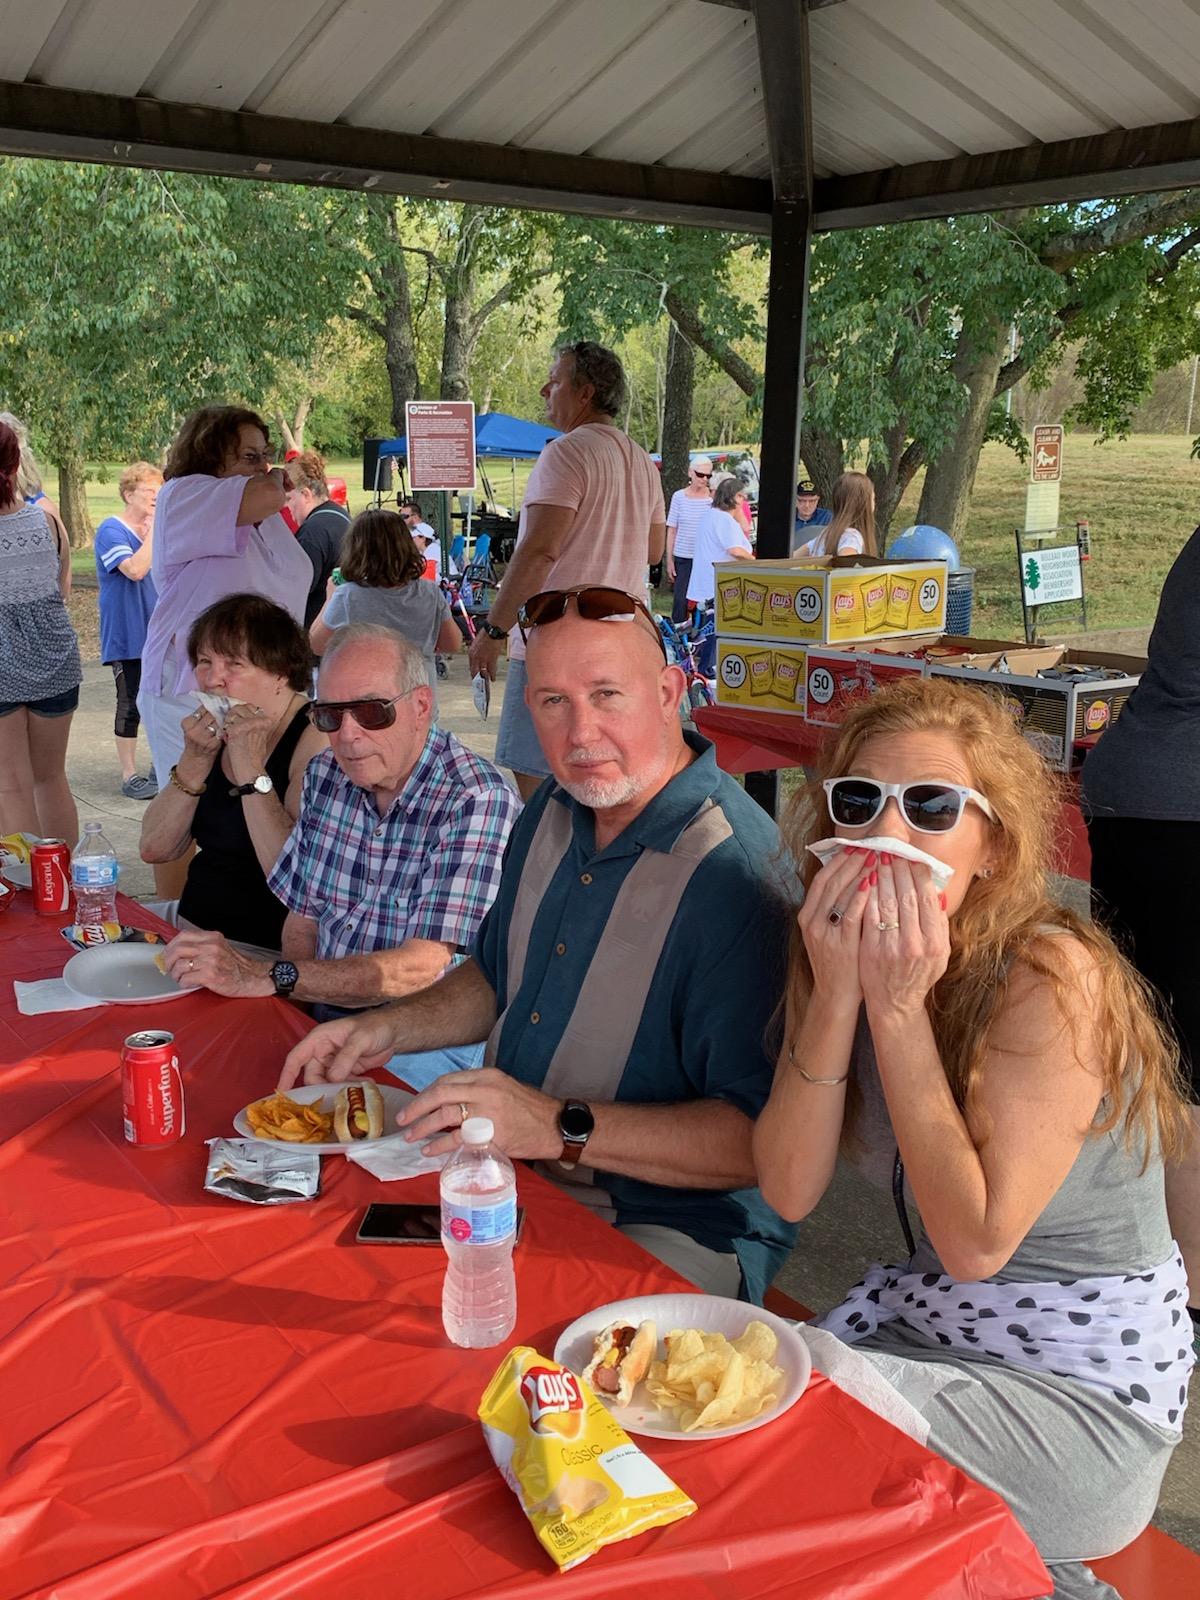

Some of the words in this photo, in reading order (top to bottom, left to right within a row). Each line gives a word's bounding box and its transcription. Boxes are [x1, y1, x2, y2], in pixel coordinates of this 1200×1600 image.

[1041, 559, 1080, 570] NEIGHBORHOOD
[1043, 570, 1072, 580] ASSOCIATION
[923, 584, 937, 599] 50
[1044, 579, 1074, 590] MEMBERSHIP
[770, 592, 793, 608] Lay's
[800, 593, 816, 609] 50
[835, 594, 855, 611] Lay's
[799, 609, 816, 617] Count
[725, 660, 741, 675] 50
[725, 674, 741, 682] Count
[813, 674, 829, 690] 50
[813, 689, 829, 698] Count
[41, 861, 56, 902] Legend
[158, 1063, 175, 1135] Superfan
[523, 1367, 577, 1423] Lay's
[561, 1444, 603, 1466] Classic
[551, 1523, 569, 1538] 160
